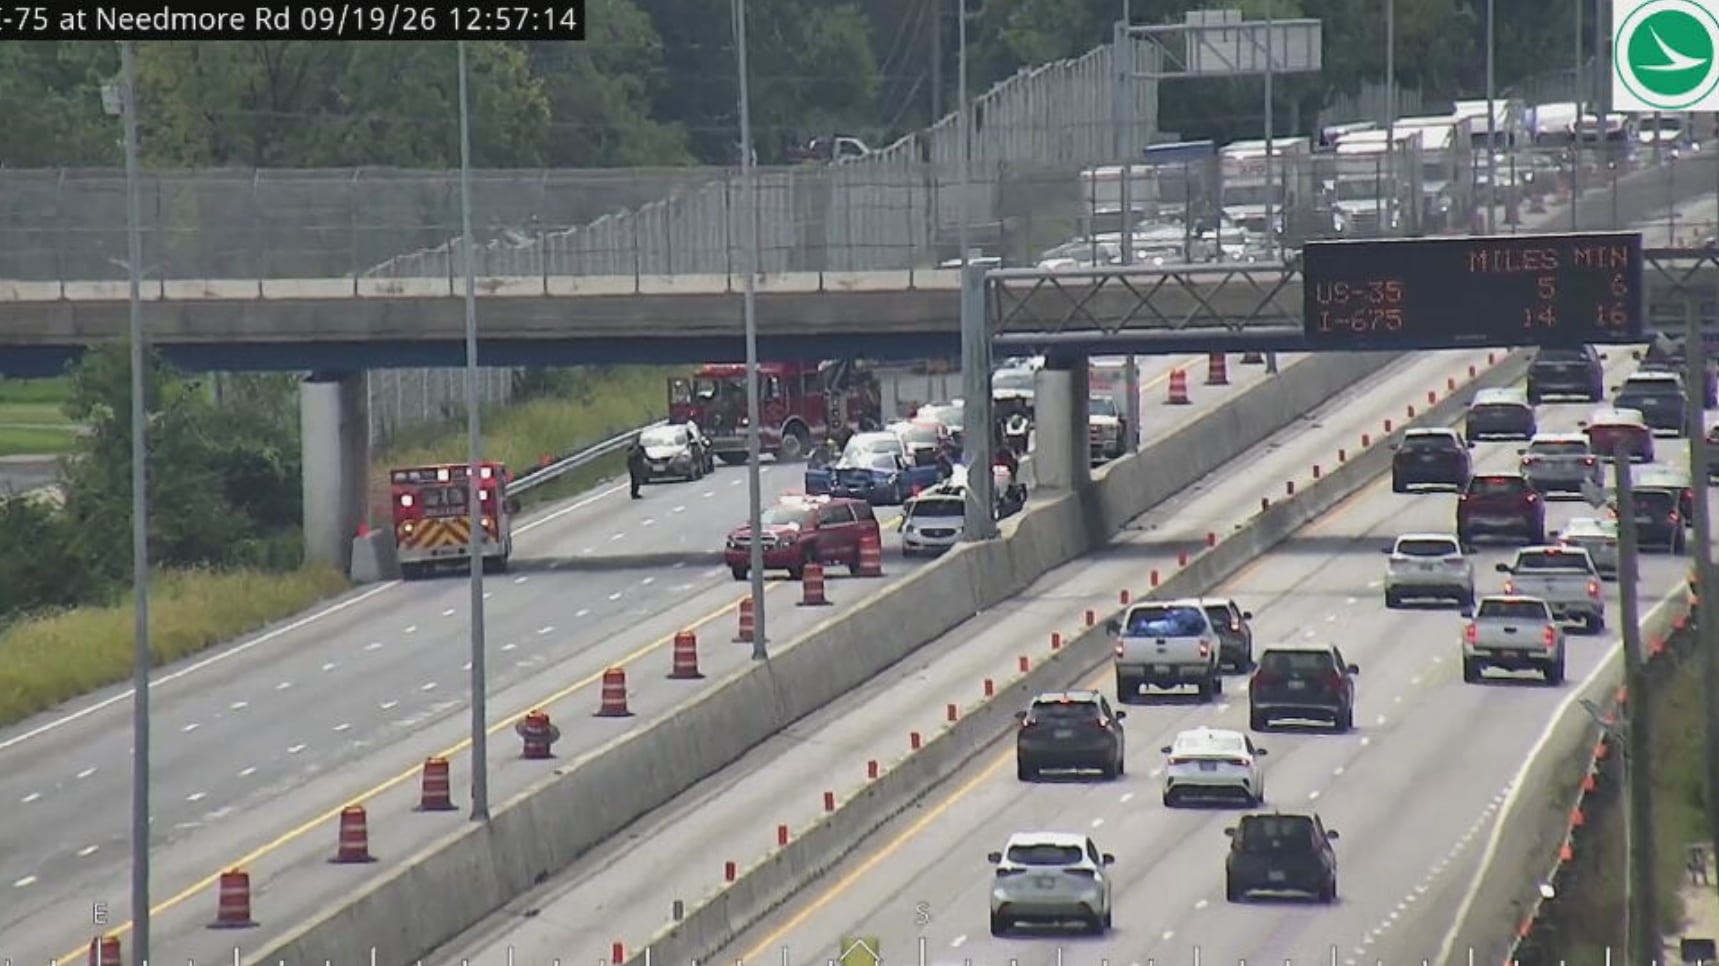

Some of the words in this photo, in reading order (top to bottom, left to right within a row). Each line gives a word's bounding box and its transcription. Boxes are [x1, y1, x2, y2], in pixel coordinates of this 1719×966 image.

[1469, 249, 1559, 272] MILES
[1574, 246, 1628, 268] MIN
[1316, 281, 1404, 304] US-35
[1537, 276, 1556, 299] 5
[1611, 273, 1628, 297] 6
[1318, 308, 1404, 332] I-675
[1523, 306, 1556, 328] 14
[1597, 302, 1628, 326] 16
